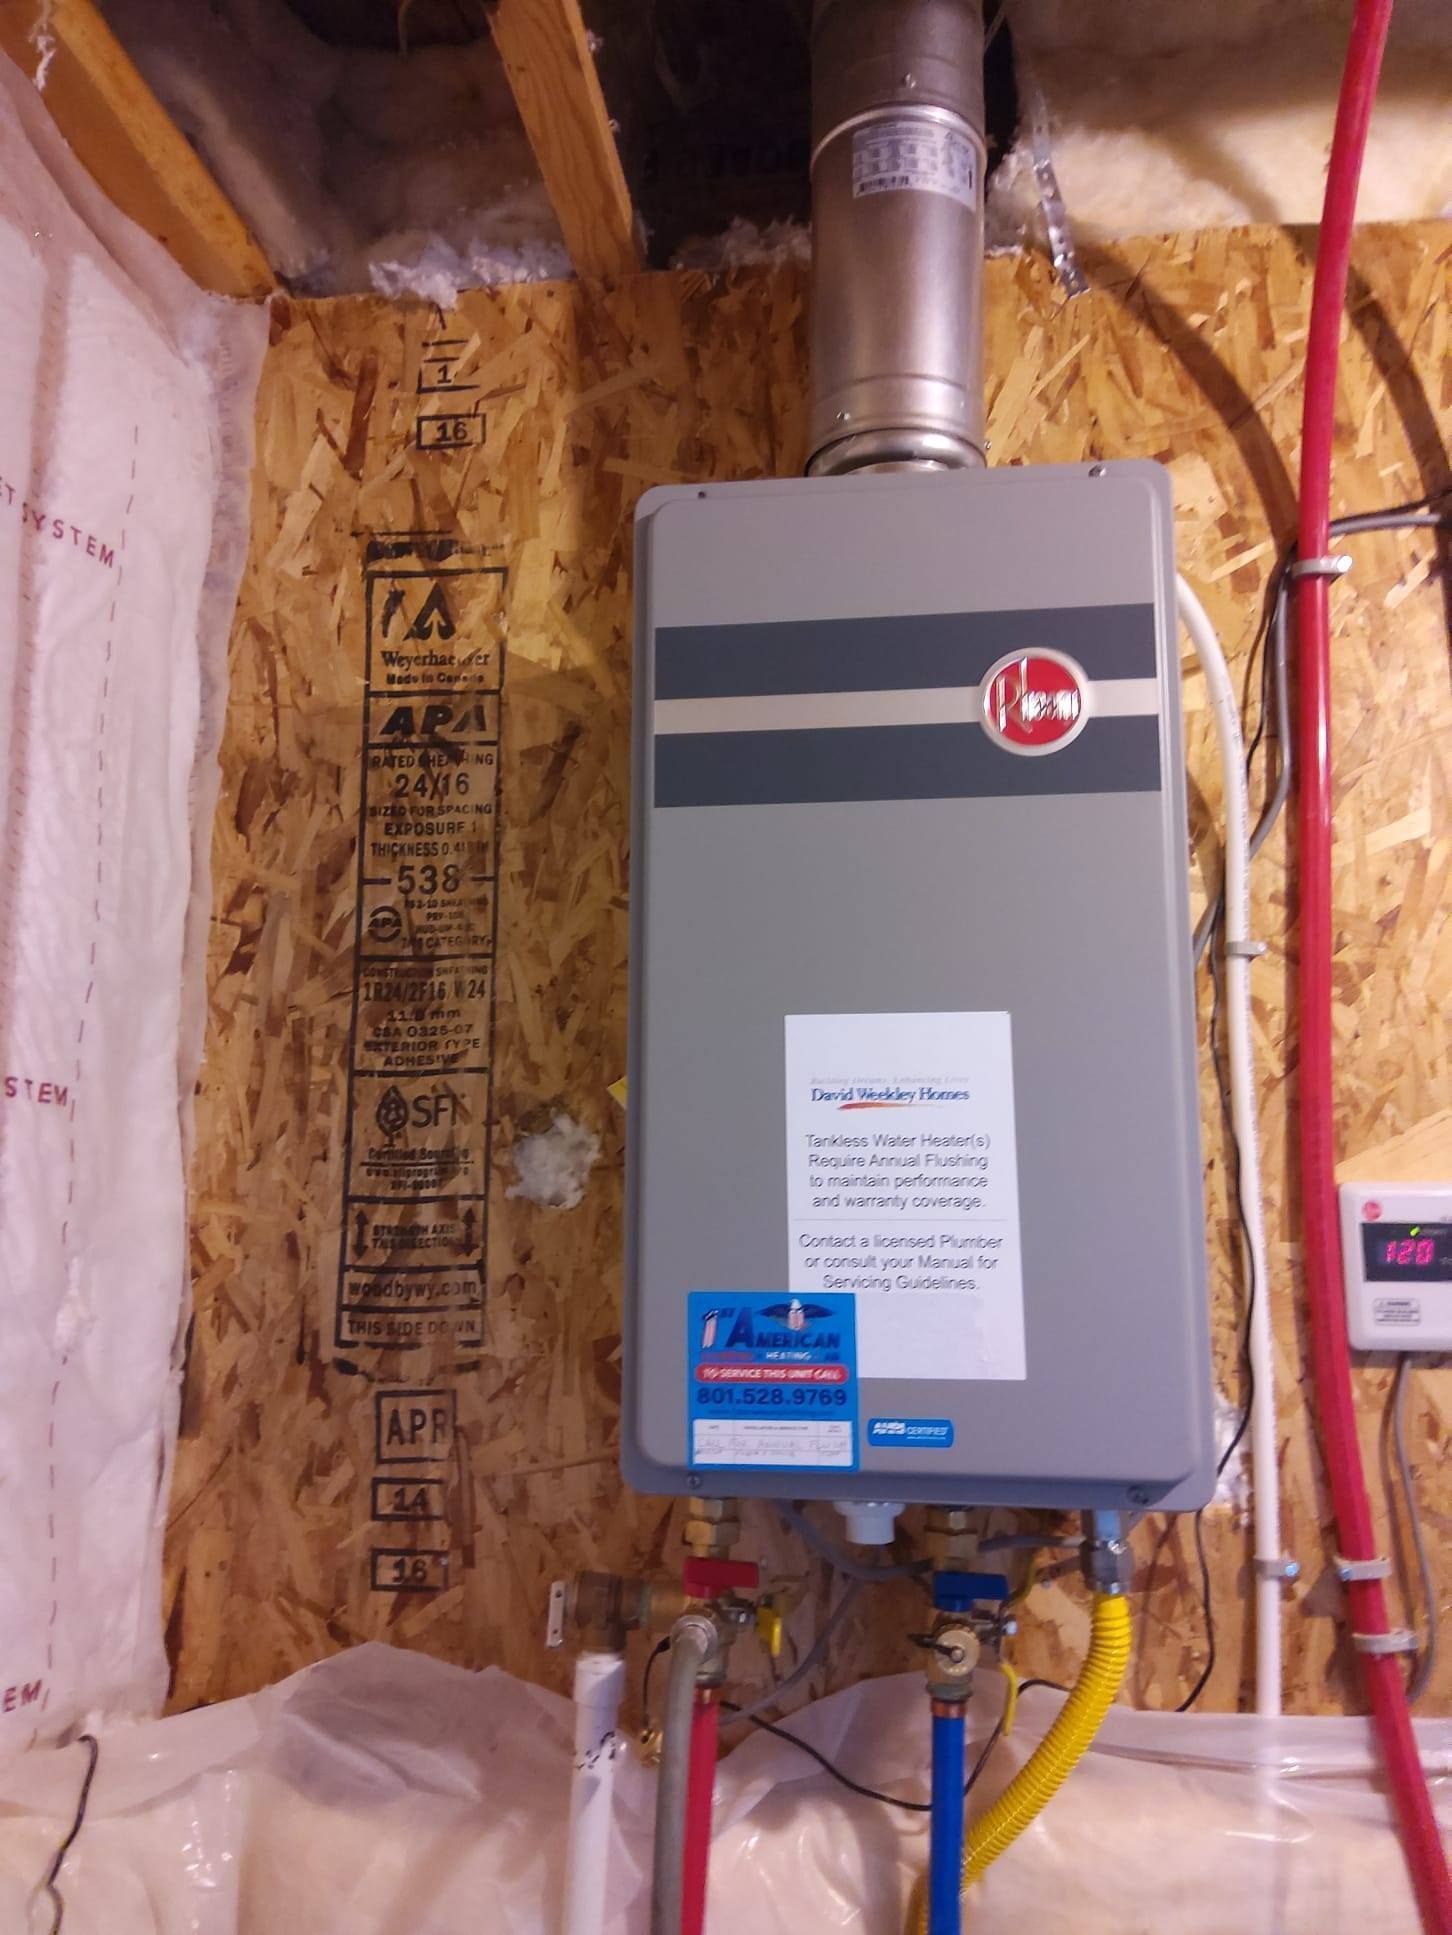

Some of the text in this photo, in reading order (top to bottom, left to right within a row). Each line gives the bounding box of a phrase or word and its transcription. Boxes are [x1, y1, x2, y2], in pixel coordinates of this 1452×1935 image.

[436, 422, 467, 441] 16
[995, 656, 1080, 734] Rheem
[379, 704, 488, 735] APA
[372, 754, 415, 769] RATED
[395, 772, 470, 800] 24/16
[437, 803, 493, 816] SPACING
[371, 842, 439, 857] THICKNESS
[397, 864, 461, 895] 538
[426, 935, 487, 948] CATEGRY
[811, 1086, 970, 1103] David Weekley Homes
[412, 1094, 457, 1128] SFI
[805, 1133, 991, 1150] Tankless Water Heater(s)
[808, 1153, 989, 1169] Require Annual Flushing
[809, 1173, 988, 1189] to maintain performance
[812, 1194, 986, 1210] and warranty coverage.
[799, 1234, 1004, 1248] Contact a licensed Plumber
[1386, 1239, 1435, 1265] 120
[804, 1255, 999, 1271] or consult your Manual for
[823, 1275, 981, 1291] Servicing Guidelines.
[348, 1320, 382, 1336] THIS
[386, 1321, 423, 1337] SIDE
[766, 1351, 812, 1361] HEATING
[703, 1368, 842, 1380] TO SERVICE THIS UNIT CALL
[697, 1387, 848, 1406] 801.528.9769
[387, 1408, 448, 1445] APR
[393, 1488, 429, 1512] 14
[392, 1558, 428, 1582] 16
